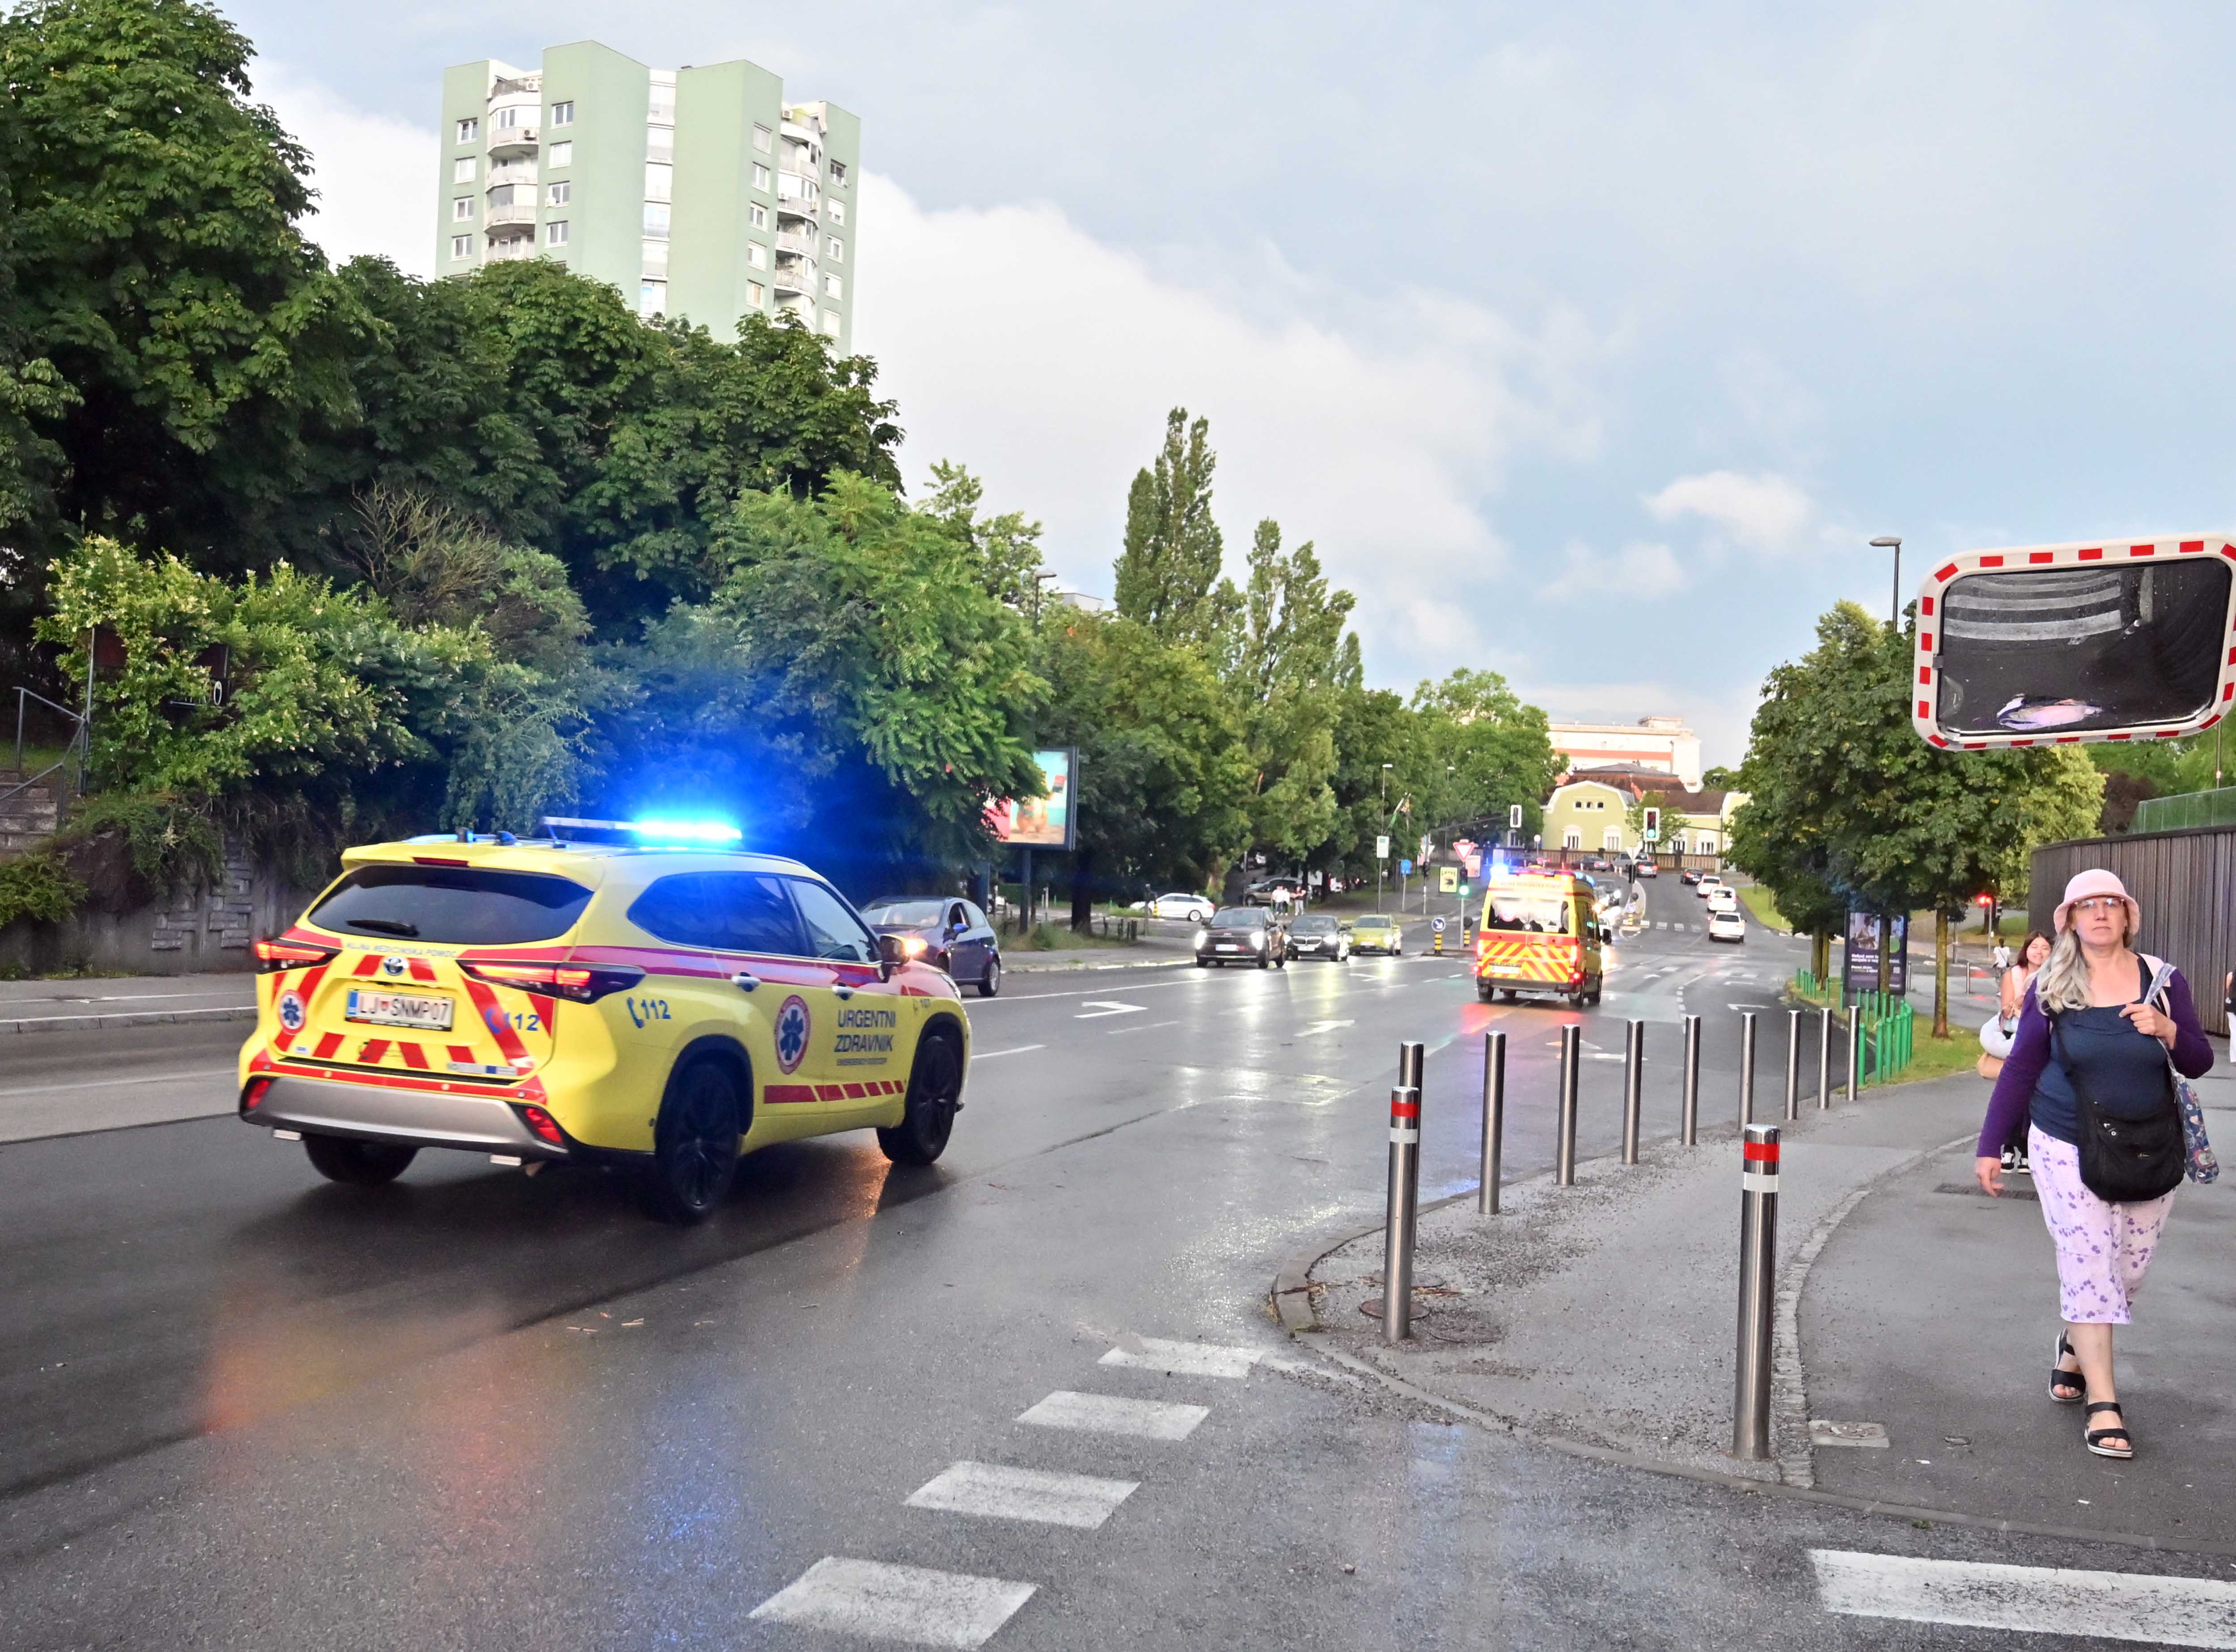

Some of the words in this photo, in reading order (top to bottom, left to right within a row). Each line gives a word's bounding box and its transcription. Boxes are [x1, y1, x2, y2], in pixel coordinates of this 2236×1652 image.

[360, 995, 379, 1014] LJ
[640, 999, 671, 1020] 112
[502, 1012, 540, 1031] 112
[838, 1009, 896, 1028] URGENTNI
[834, 1034, 894, 1052] ZDRAVNIK
